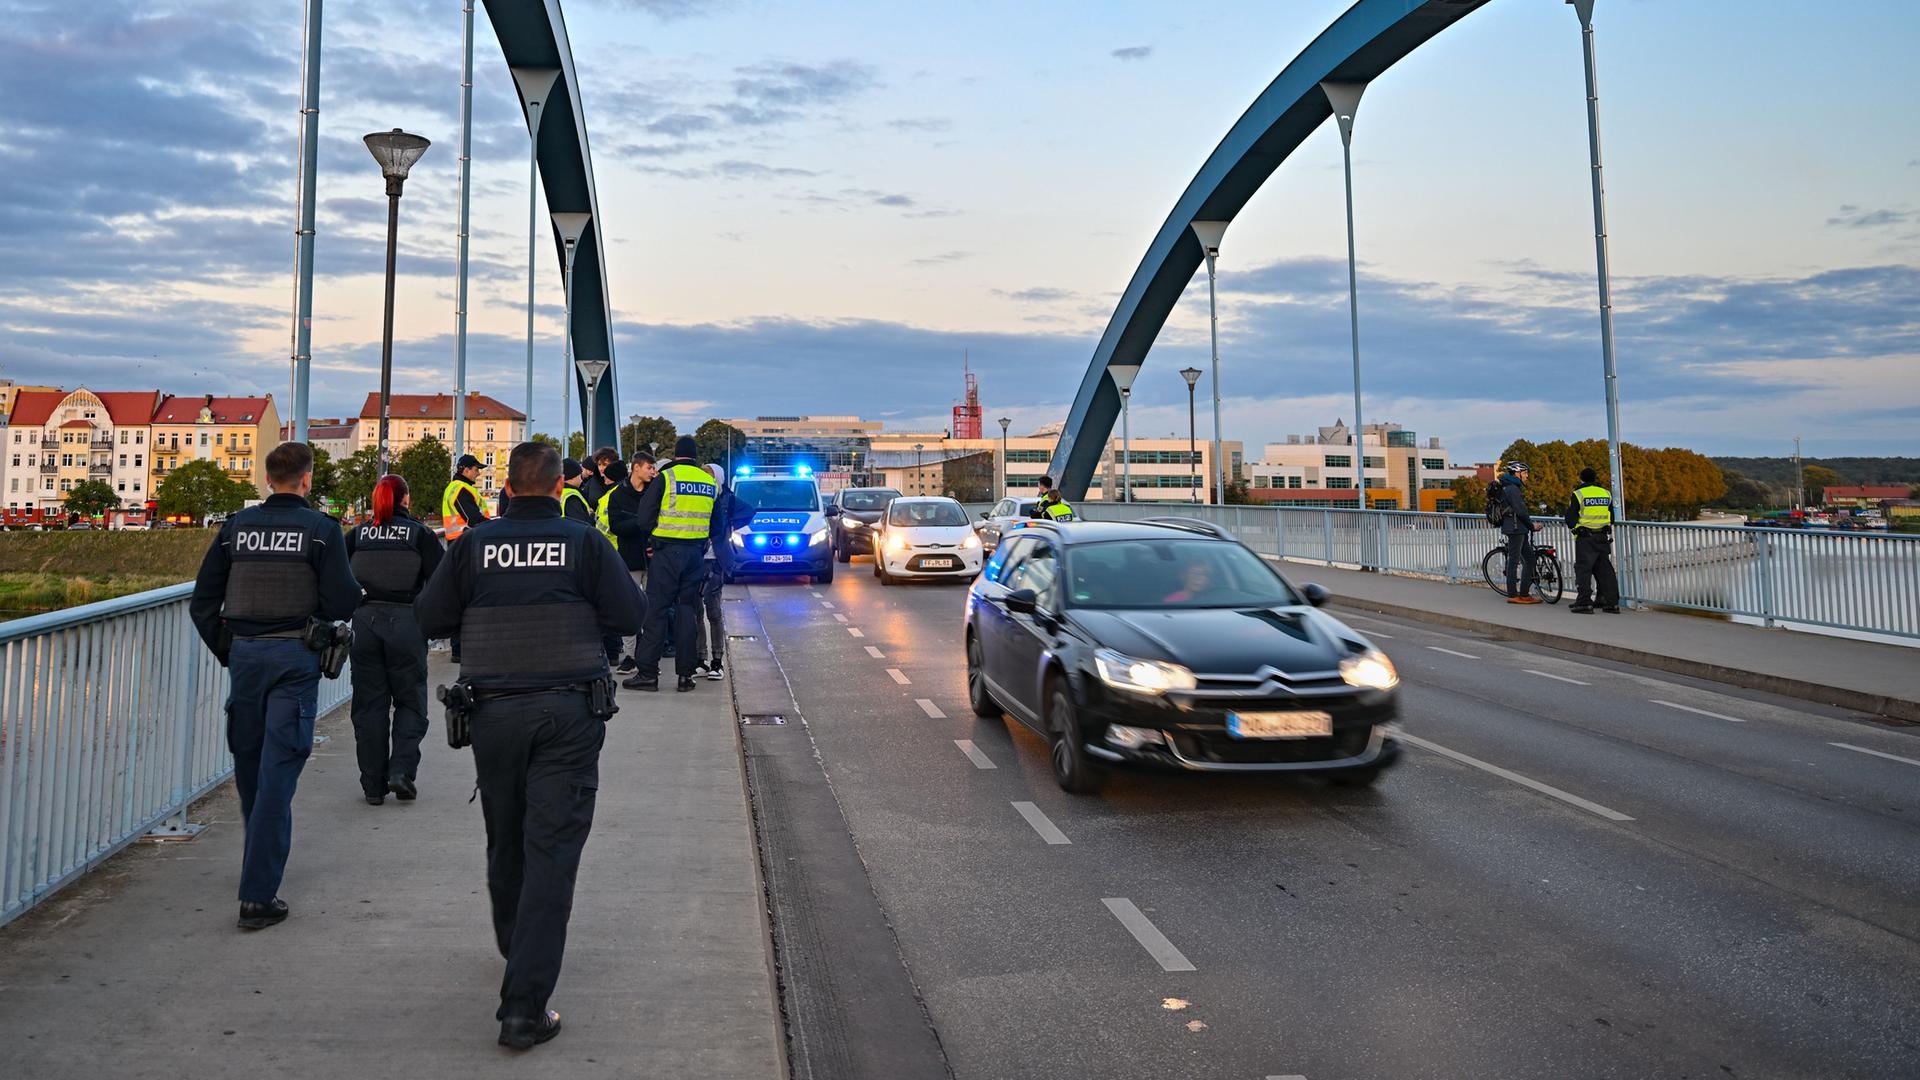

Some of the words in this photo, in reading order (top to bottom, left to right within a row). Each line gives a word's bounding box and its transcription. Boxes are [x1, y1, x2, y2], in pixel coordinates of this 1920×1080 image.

[236, 531, 303, 552] POLIZEI
[360, 525, 410, 541] POLIZEI
[483, 542, 566, 569] POLIZEI
